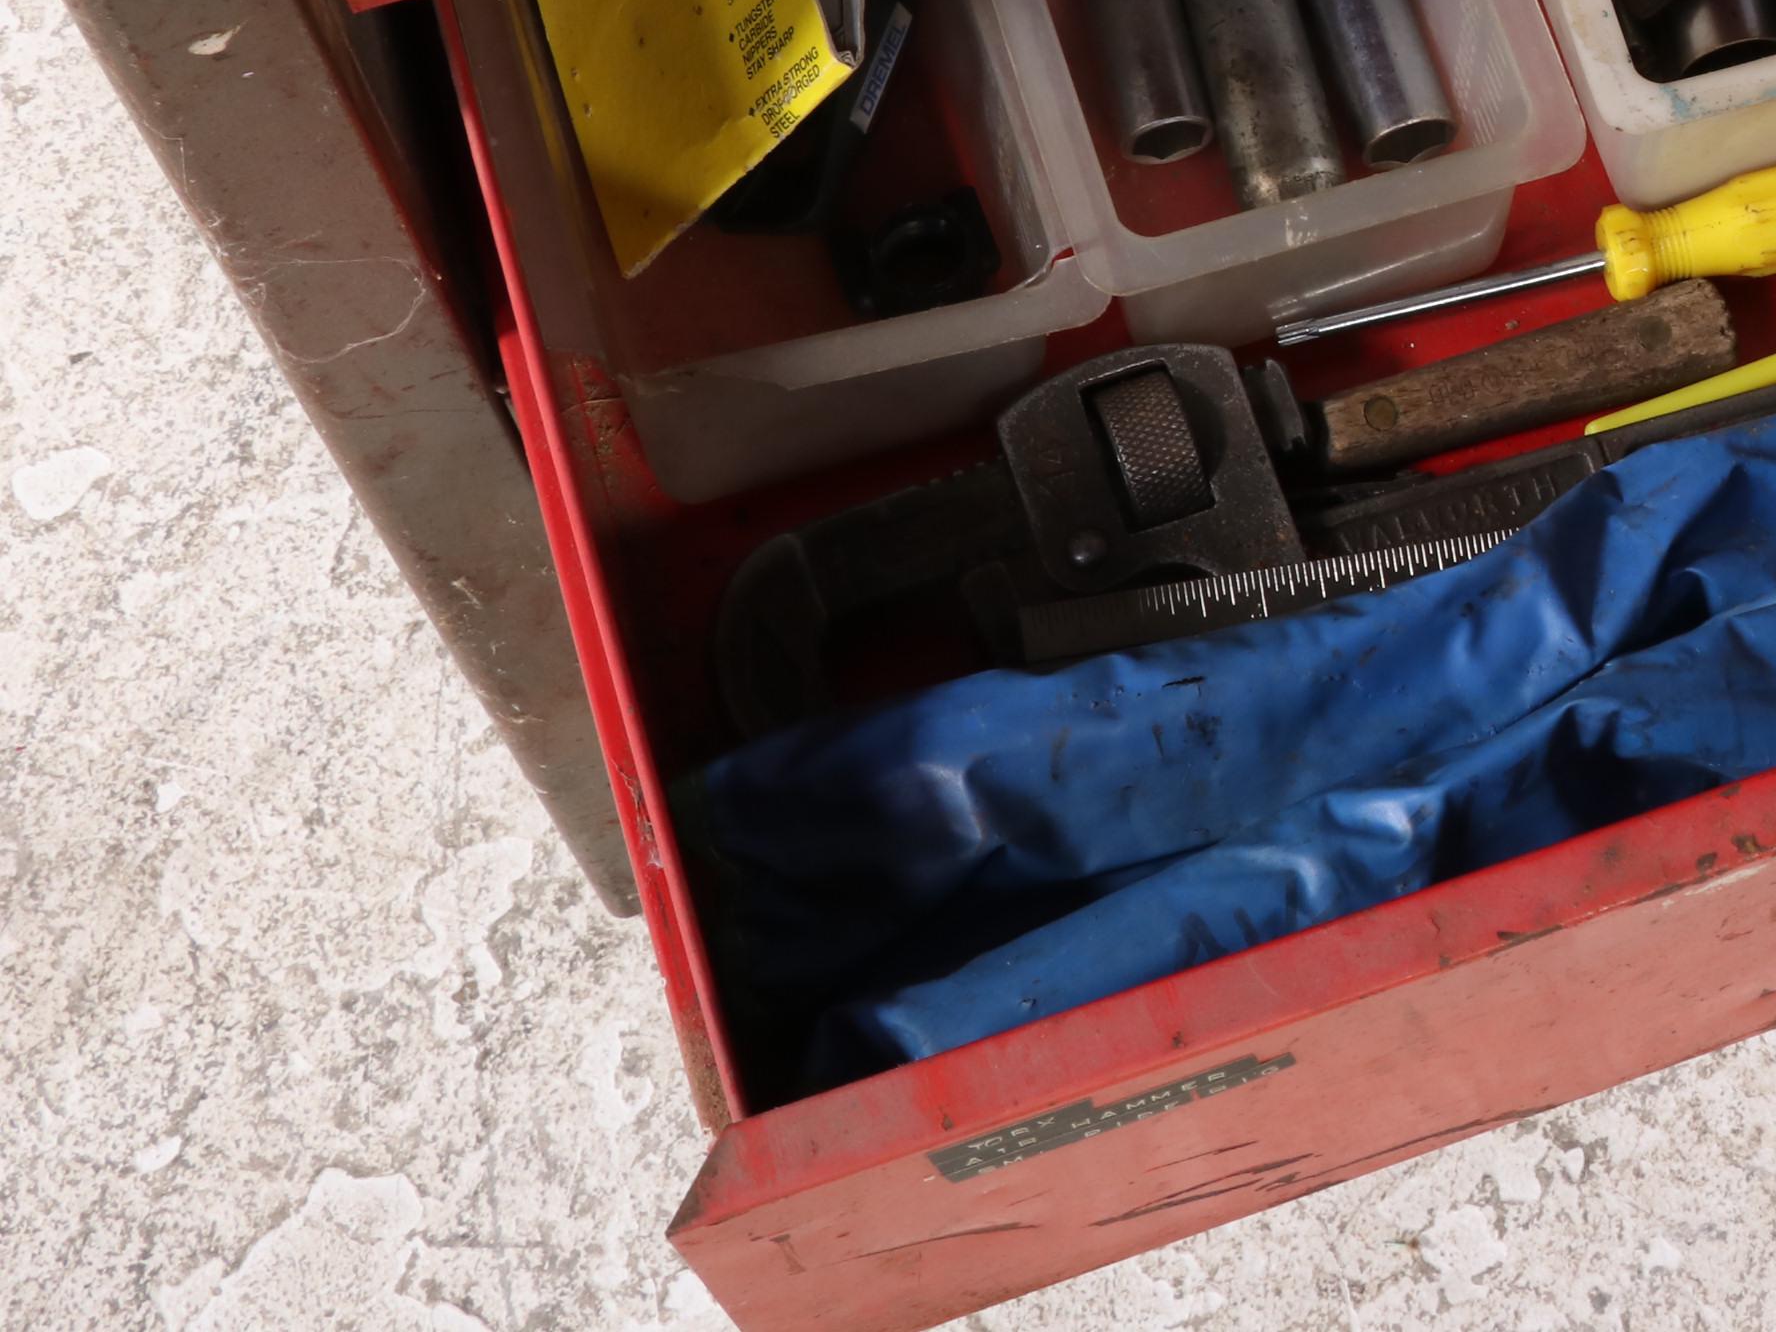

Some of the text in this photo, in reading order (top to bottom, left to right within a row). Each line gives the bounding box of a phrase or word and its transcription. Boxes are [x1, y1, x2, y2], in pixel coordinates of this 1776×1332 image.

[738, 10, 776, 51] CARBIDE
[742, 25, 778, 66] NIPPERS
[747, 25, 795, 80] STAY SHARP
[754, 45, 820, 112] EXTRA STRONG
[860, 26, 908, 117] DREMEL
[769, 109, 801, 140] STEEL
[1071, 1070, 1226, 1130] HAMMER
[967, 1115, 1056, 1151] TORX
